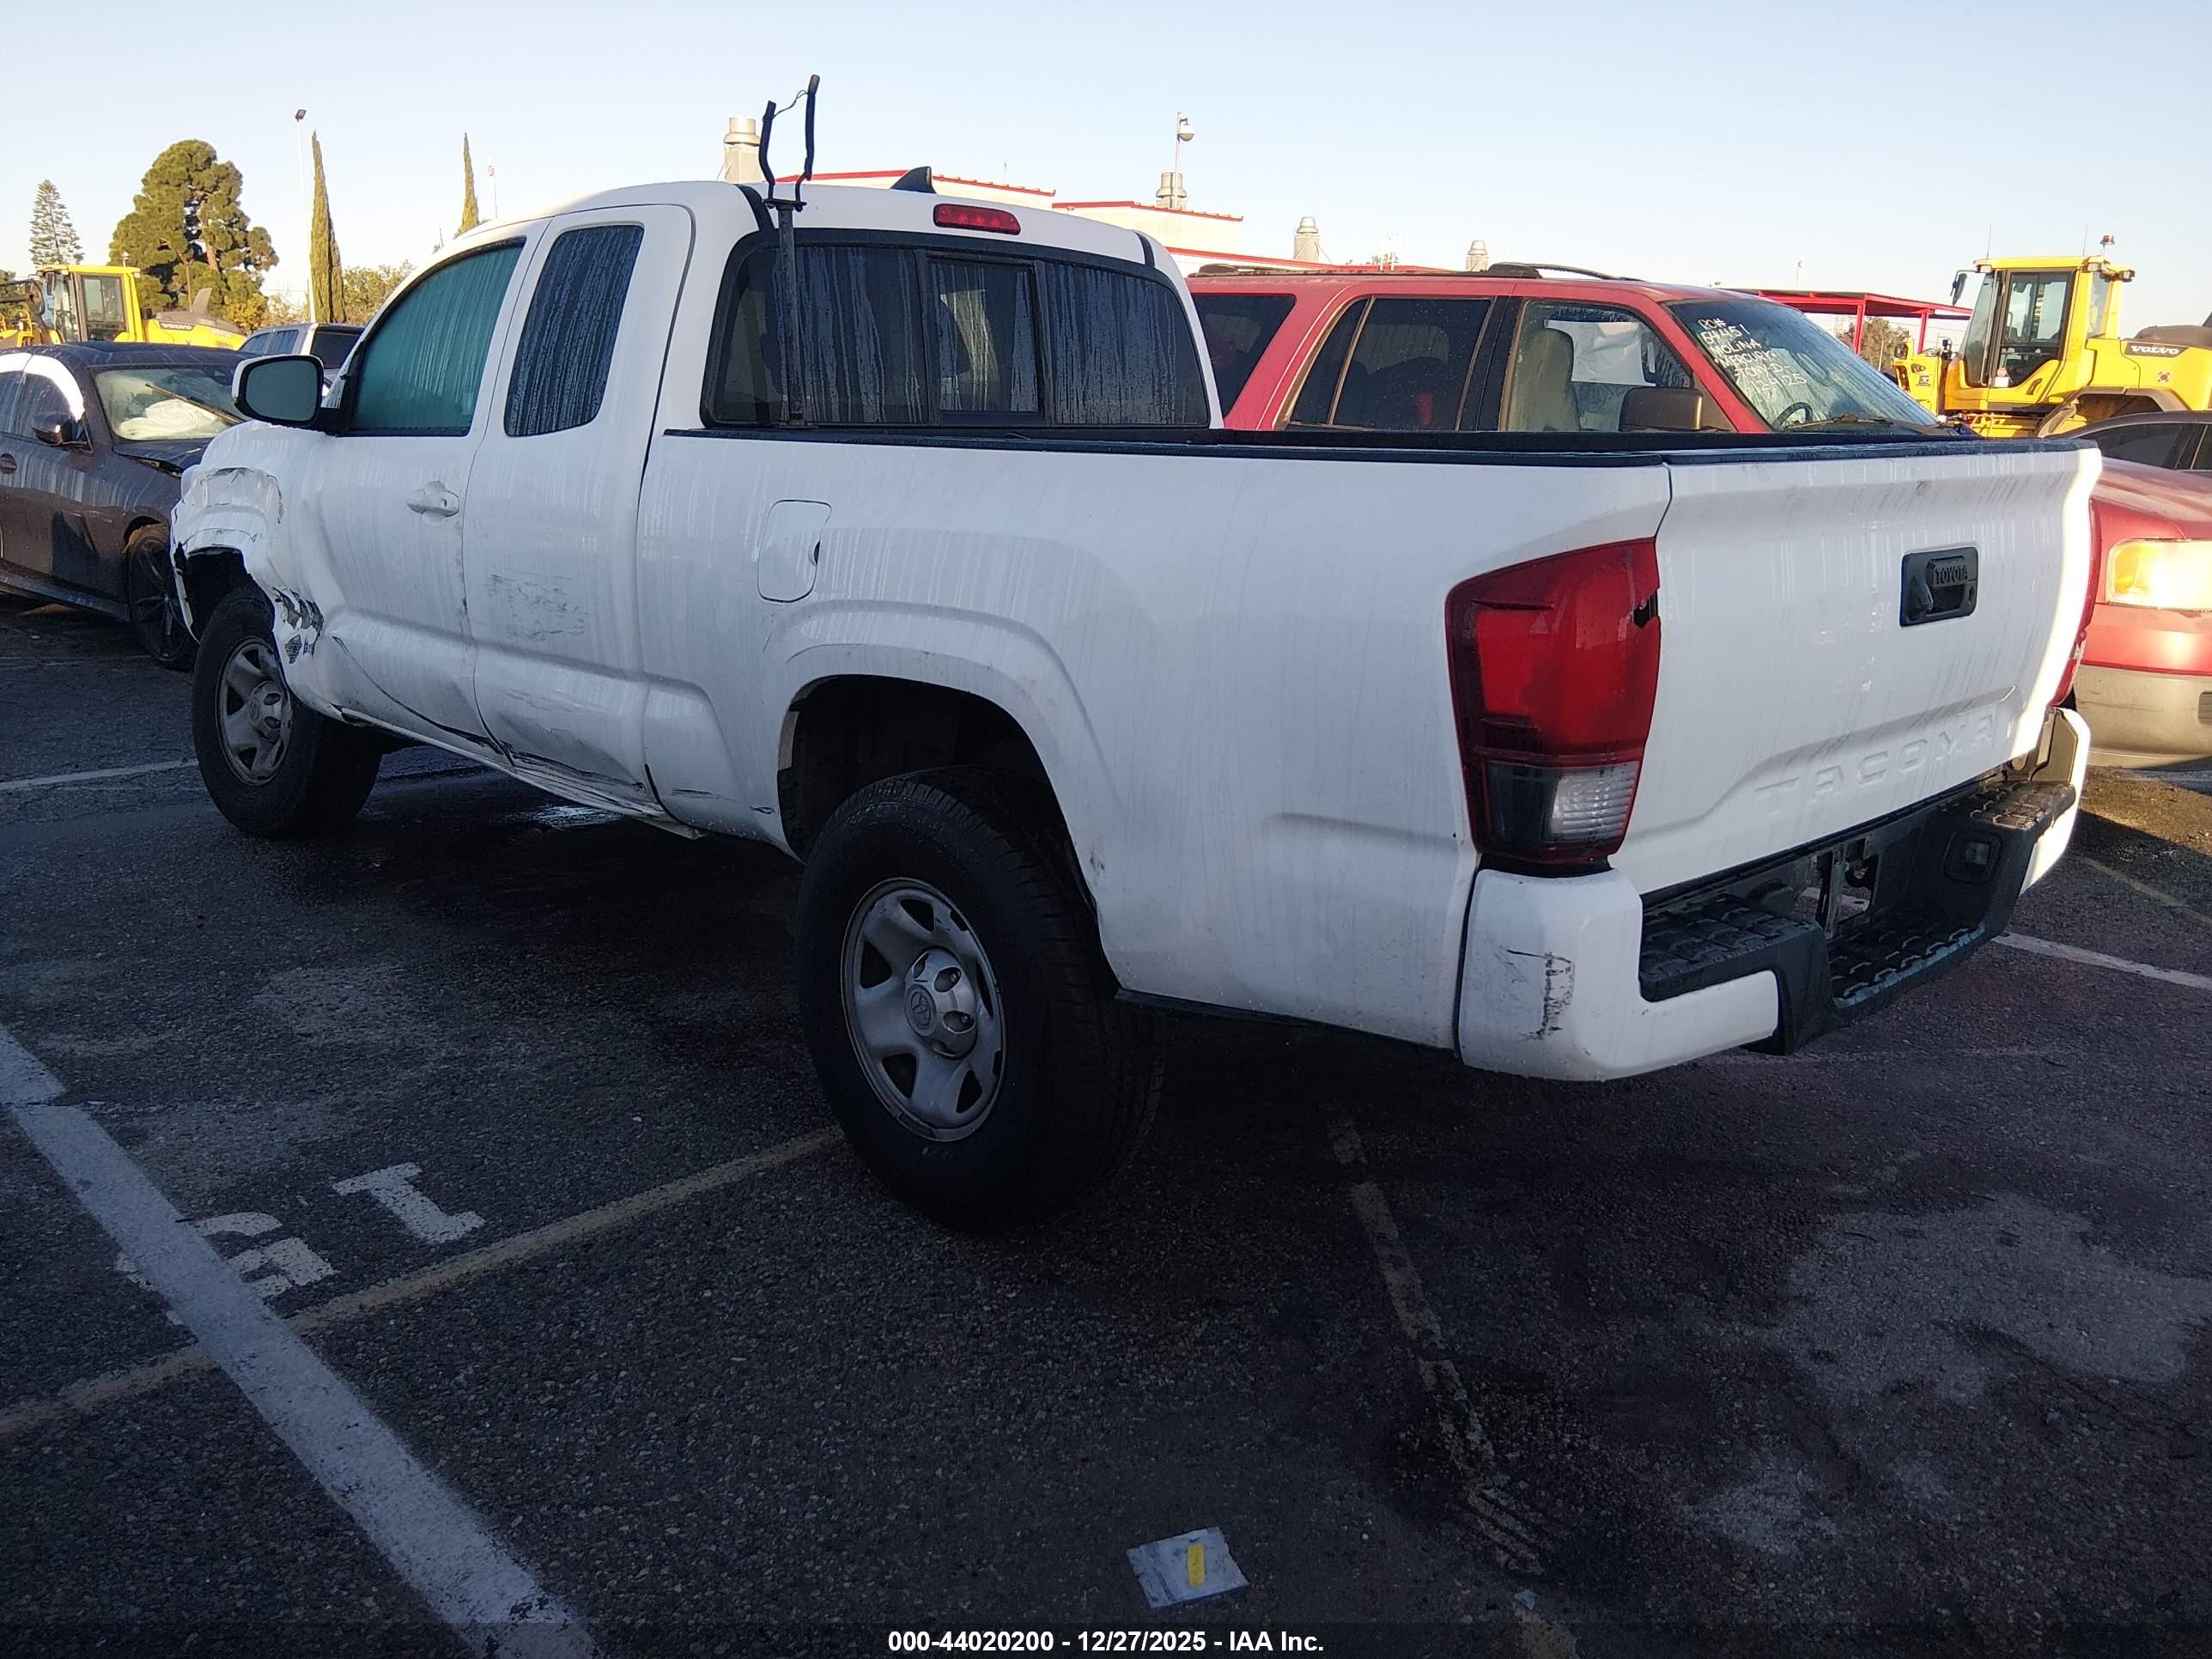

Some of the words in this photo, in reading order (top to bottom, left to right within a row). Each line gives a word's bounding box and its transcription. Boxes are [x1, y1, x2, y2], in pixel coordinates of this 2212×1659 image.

[2130, 345, 2179, 355] VOLVO
[1936, 564, 1968, 585] TOYOTA
[1754, 713, 1994, 817] TACOMA
